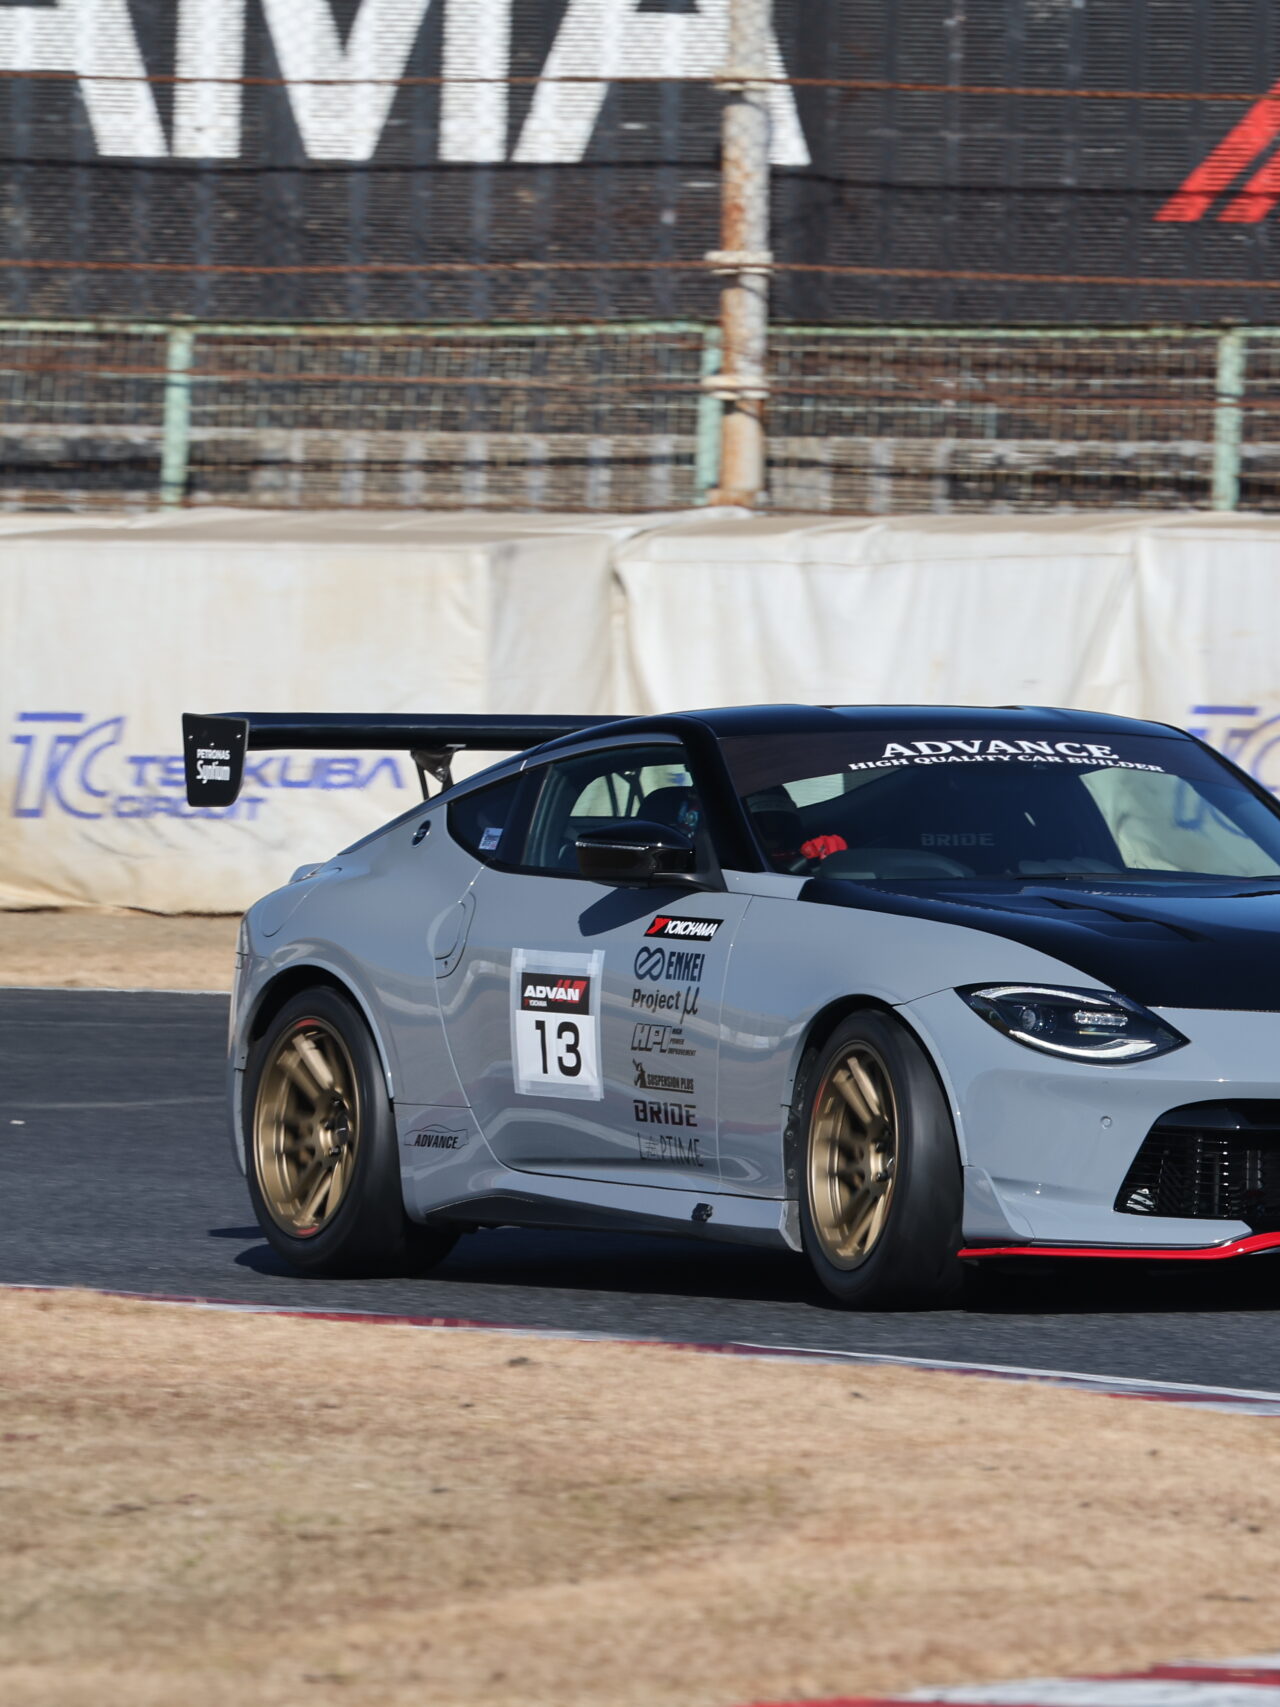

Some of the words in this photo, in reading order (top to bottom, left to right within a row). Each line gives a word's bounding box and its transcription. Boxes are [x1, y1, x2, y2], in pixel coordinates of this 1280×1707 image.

[196, 748, 231, 760] PETRONAS
[882, 740, 1120, 759] ADVANCE
[125, 755, 406, 790] TSKUBA
[848, 757, 911, 771] HIGH
[913, 754, 1011, 765] QUALITY
[1017, 754, 1064, 764] CAR
[1066, 756, 1166, 773] BUILDER
[920, 832, 997, 848] BRIDE
[664, 920, 719, 937] YOKOHAMA
[665, 951, 706, 983] ENKEI
[523, 984, 580, 1001] ADVAN
[631, 988, 681, 1013] Project
[631, 1022, 673, 1053] HPI
[535, 1019, 582, 1077] 13
[633, 1099, 698, 1128] BRIDE
[413, 1134, 459, 1150] ADVANCE
